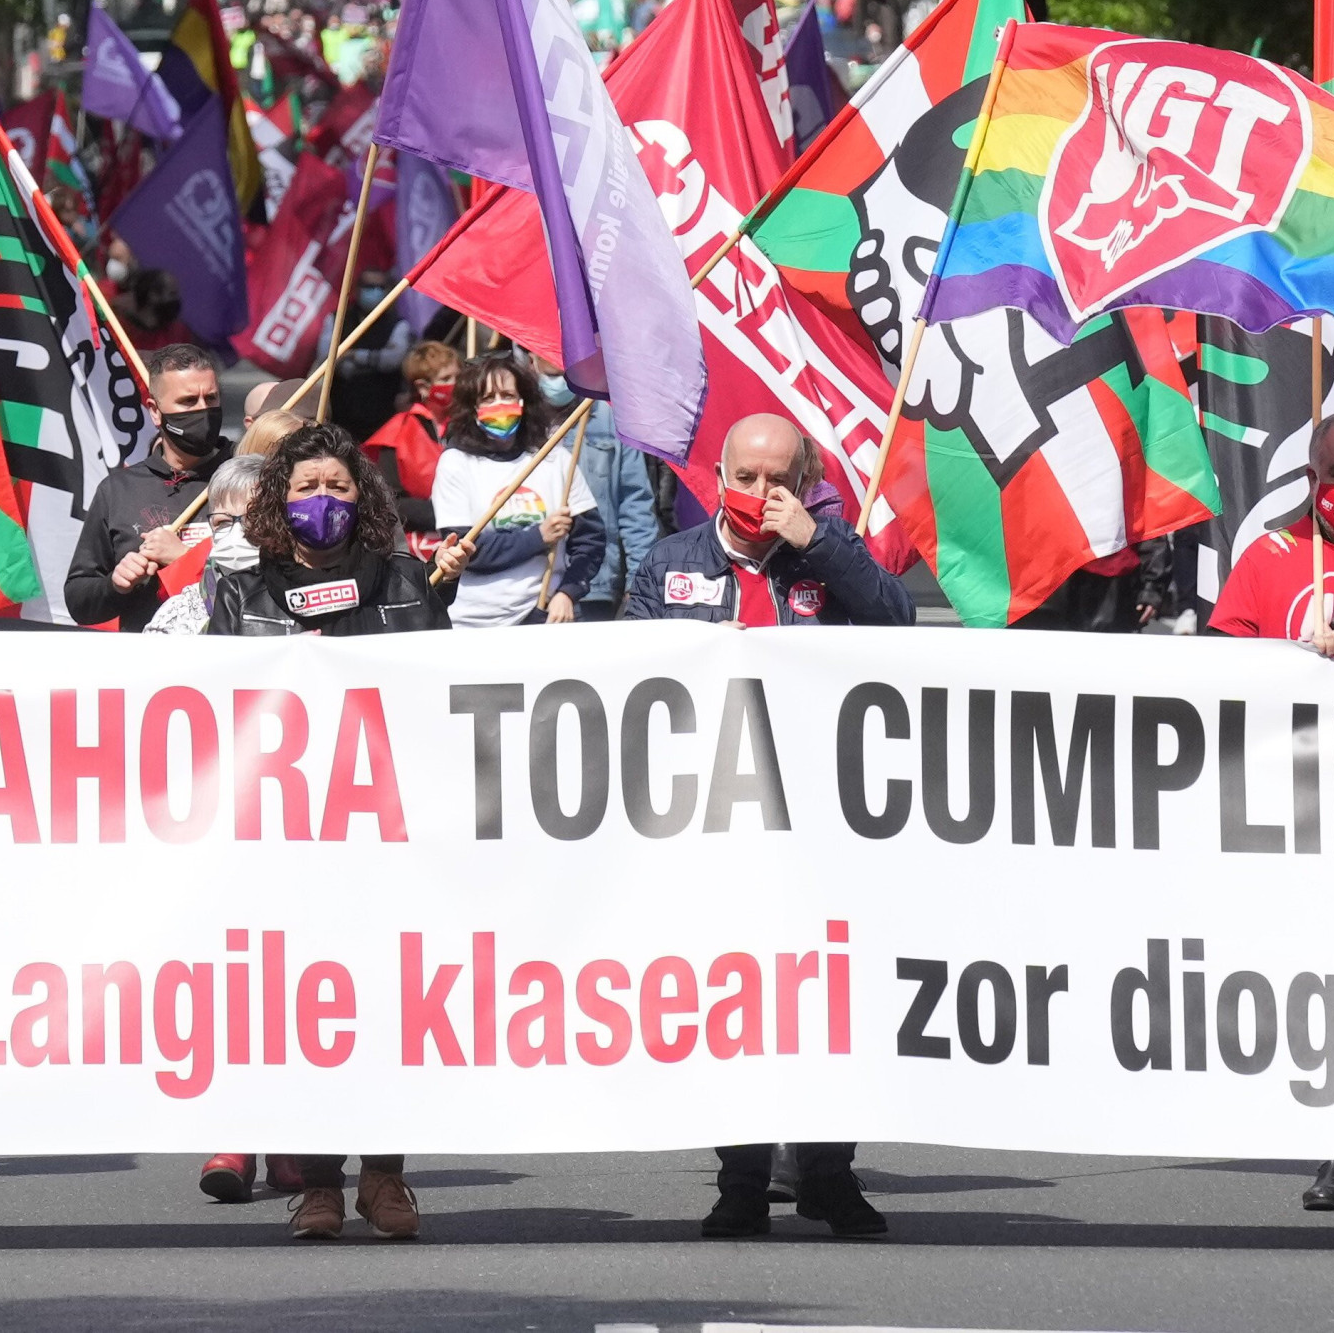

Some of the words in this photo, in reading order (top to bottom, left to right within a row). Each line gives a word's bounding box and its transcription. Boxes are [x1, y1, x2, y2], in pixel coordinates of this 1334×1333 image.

[1093, 62, 1291, 192] UGT
[307, 587, 353, 605] CCOO
[794, 589, 818, 603] UGT
[449, 677, 793, 841] TOCA
[399, 918, 851, 1068] klaseari
[895, 957, 1068, 1066] zor
